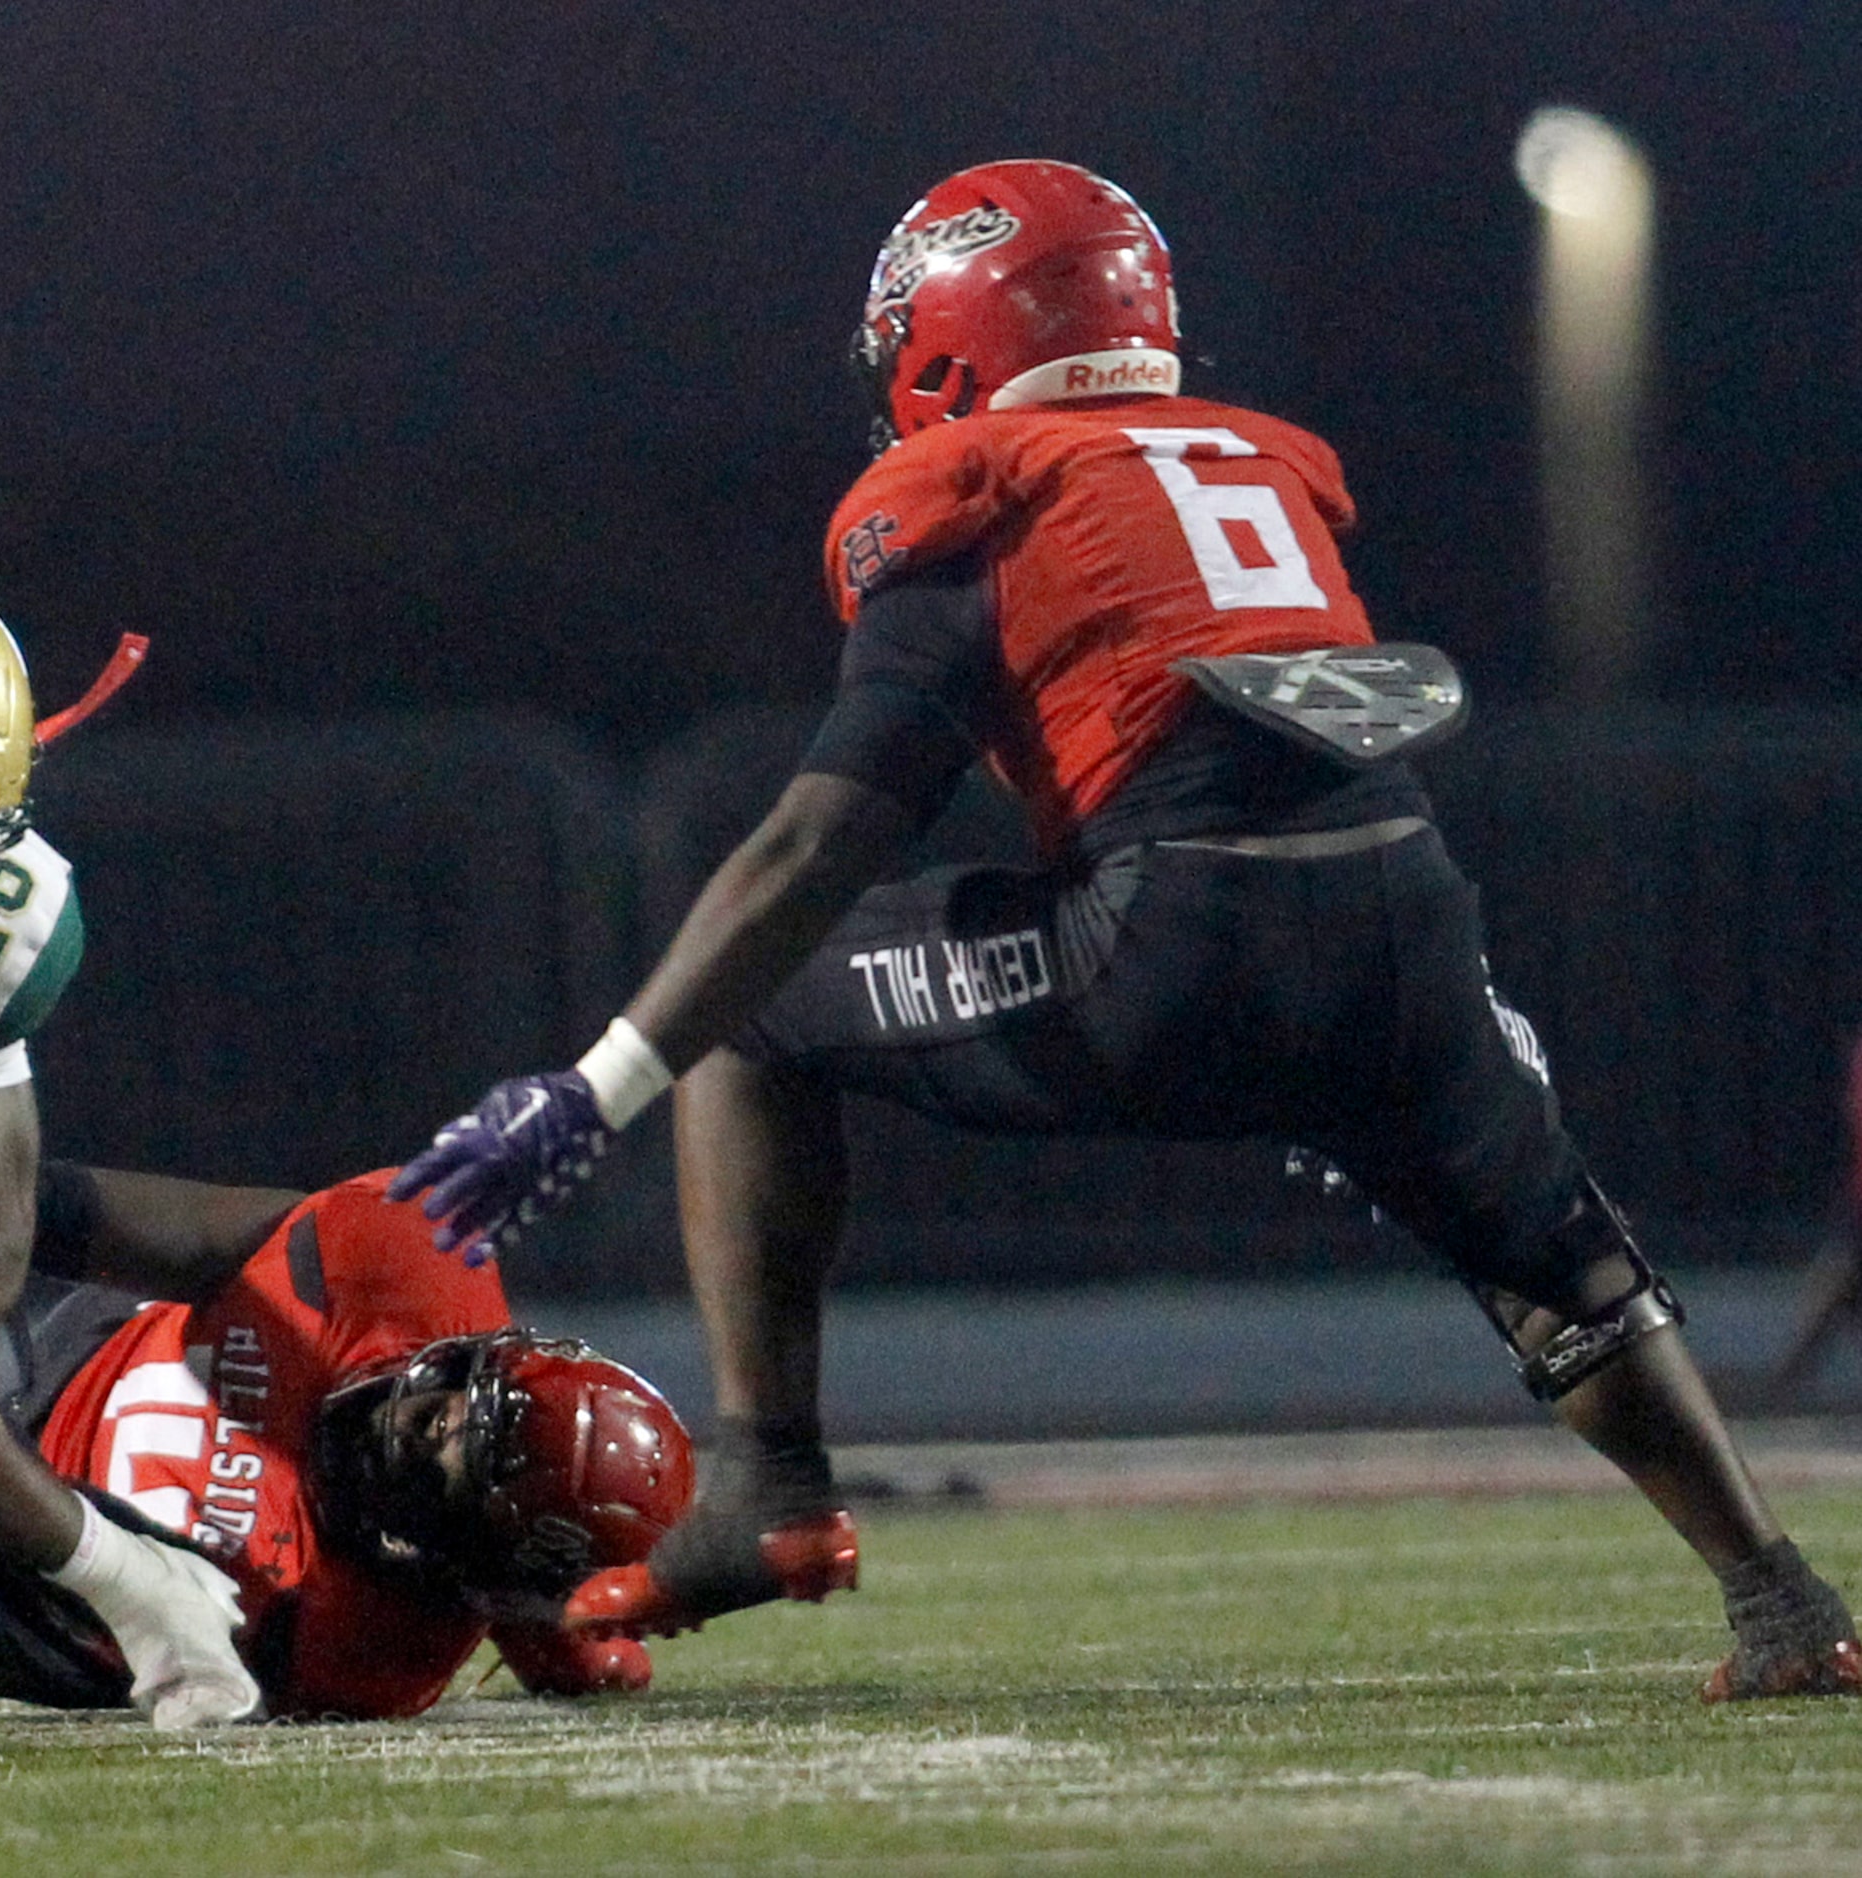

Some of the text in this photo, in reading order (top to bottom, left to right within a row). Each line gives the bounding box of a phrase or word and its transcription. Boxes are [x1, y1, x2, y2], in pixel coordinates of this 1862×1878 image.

[1116, 426, 1330, 612] 6
[848, 928, 1051, 1031] CEDAR HILL
